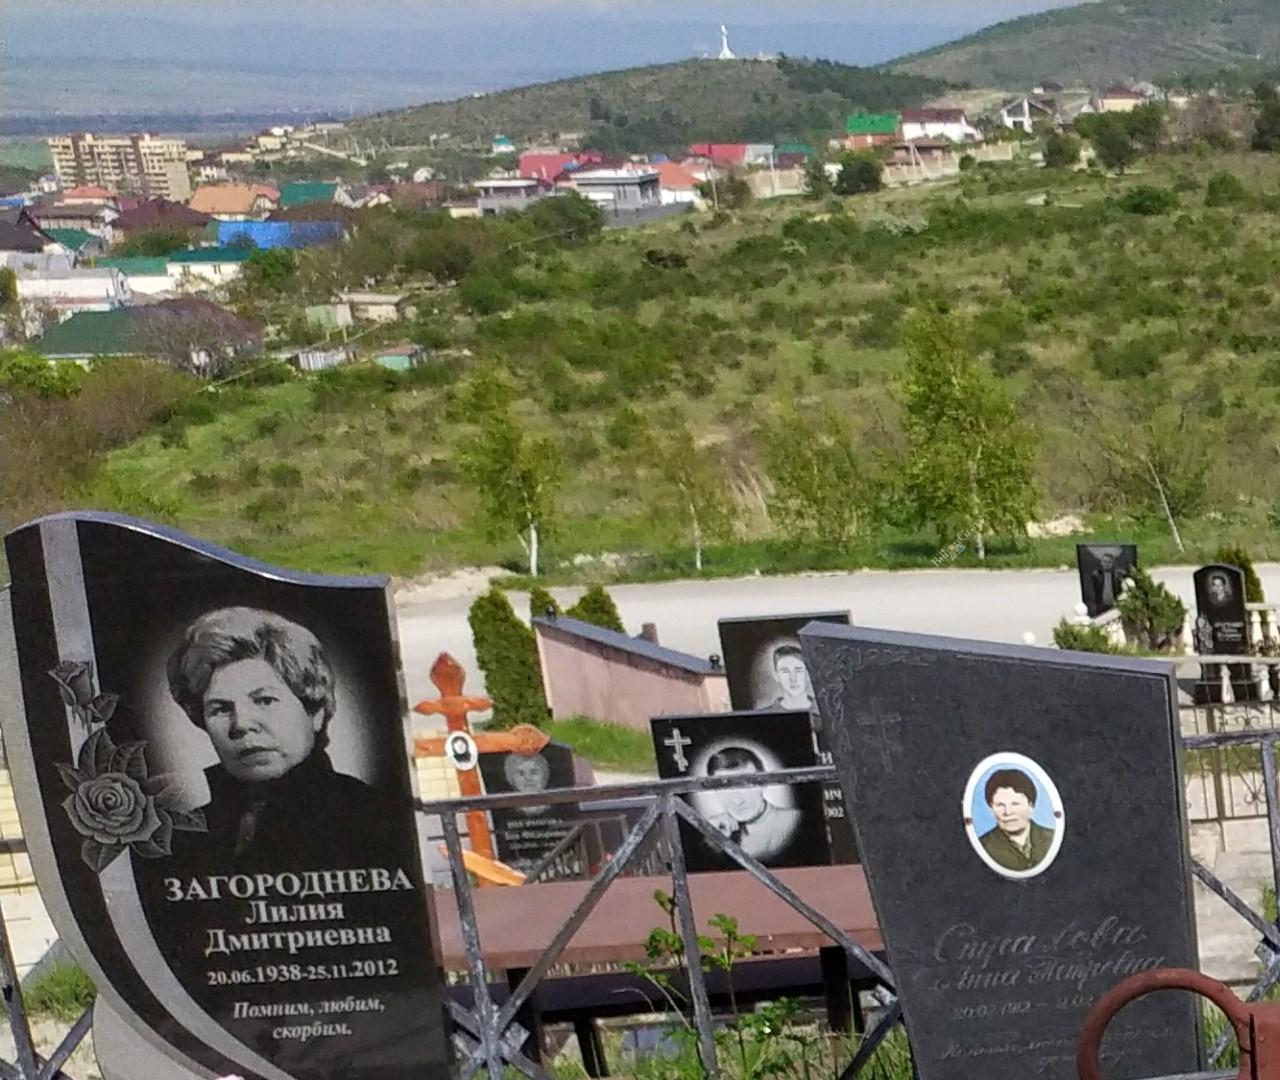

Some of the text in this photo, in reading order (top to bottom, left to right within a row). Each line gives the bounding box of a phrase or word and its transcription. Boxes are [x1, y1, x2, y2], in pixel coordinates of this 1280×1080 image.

[164, 867, 415, 901] ЗАГОРОДНЕВА
[244, 899, 345, 924] Лилия
[204, 924, 392, 957] Дмитриевна
[206, 958, 400, 986] 20.06.1938-25.11.2012
[232, 995, 386, 1019] Помним, любим,
[272, 1022, 353, 1041] скорбим.
